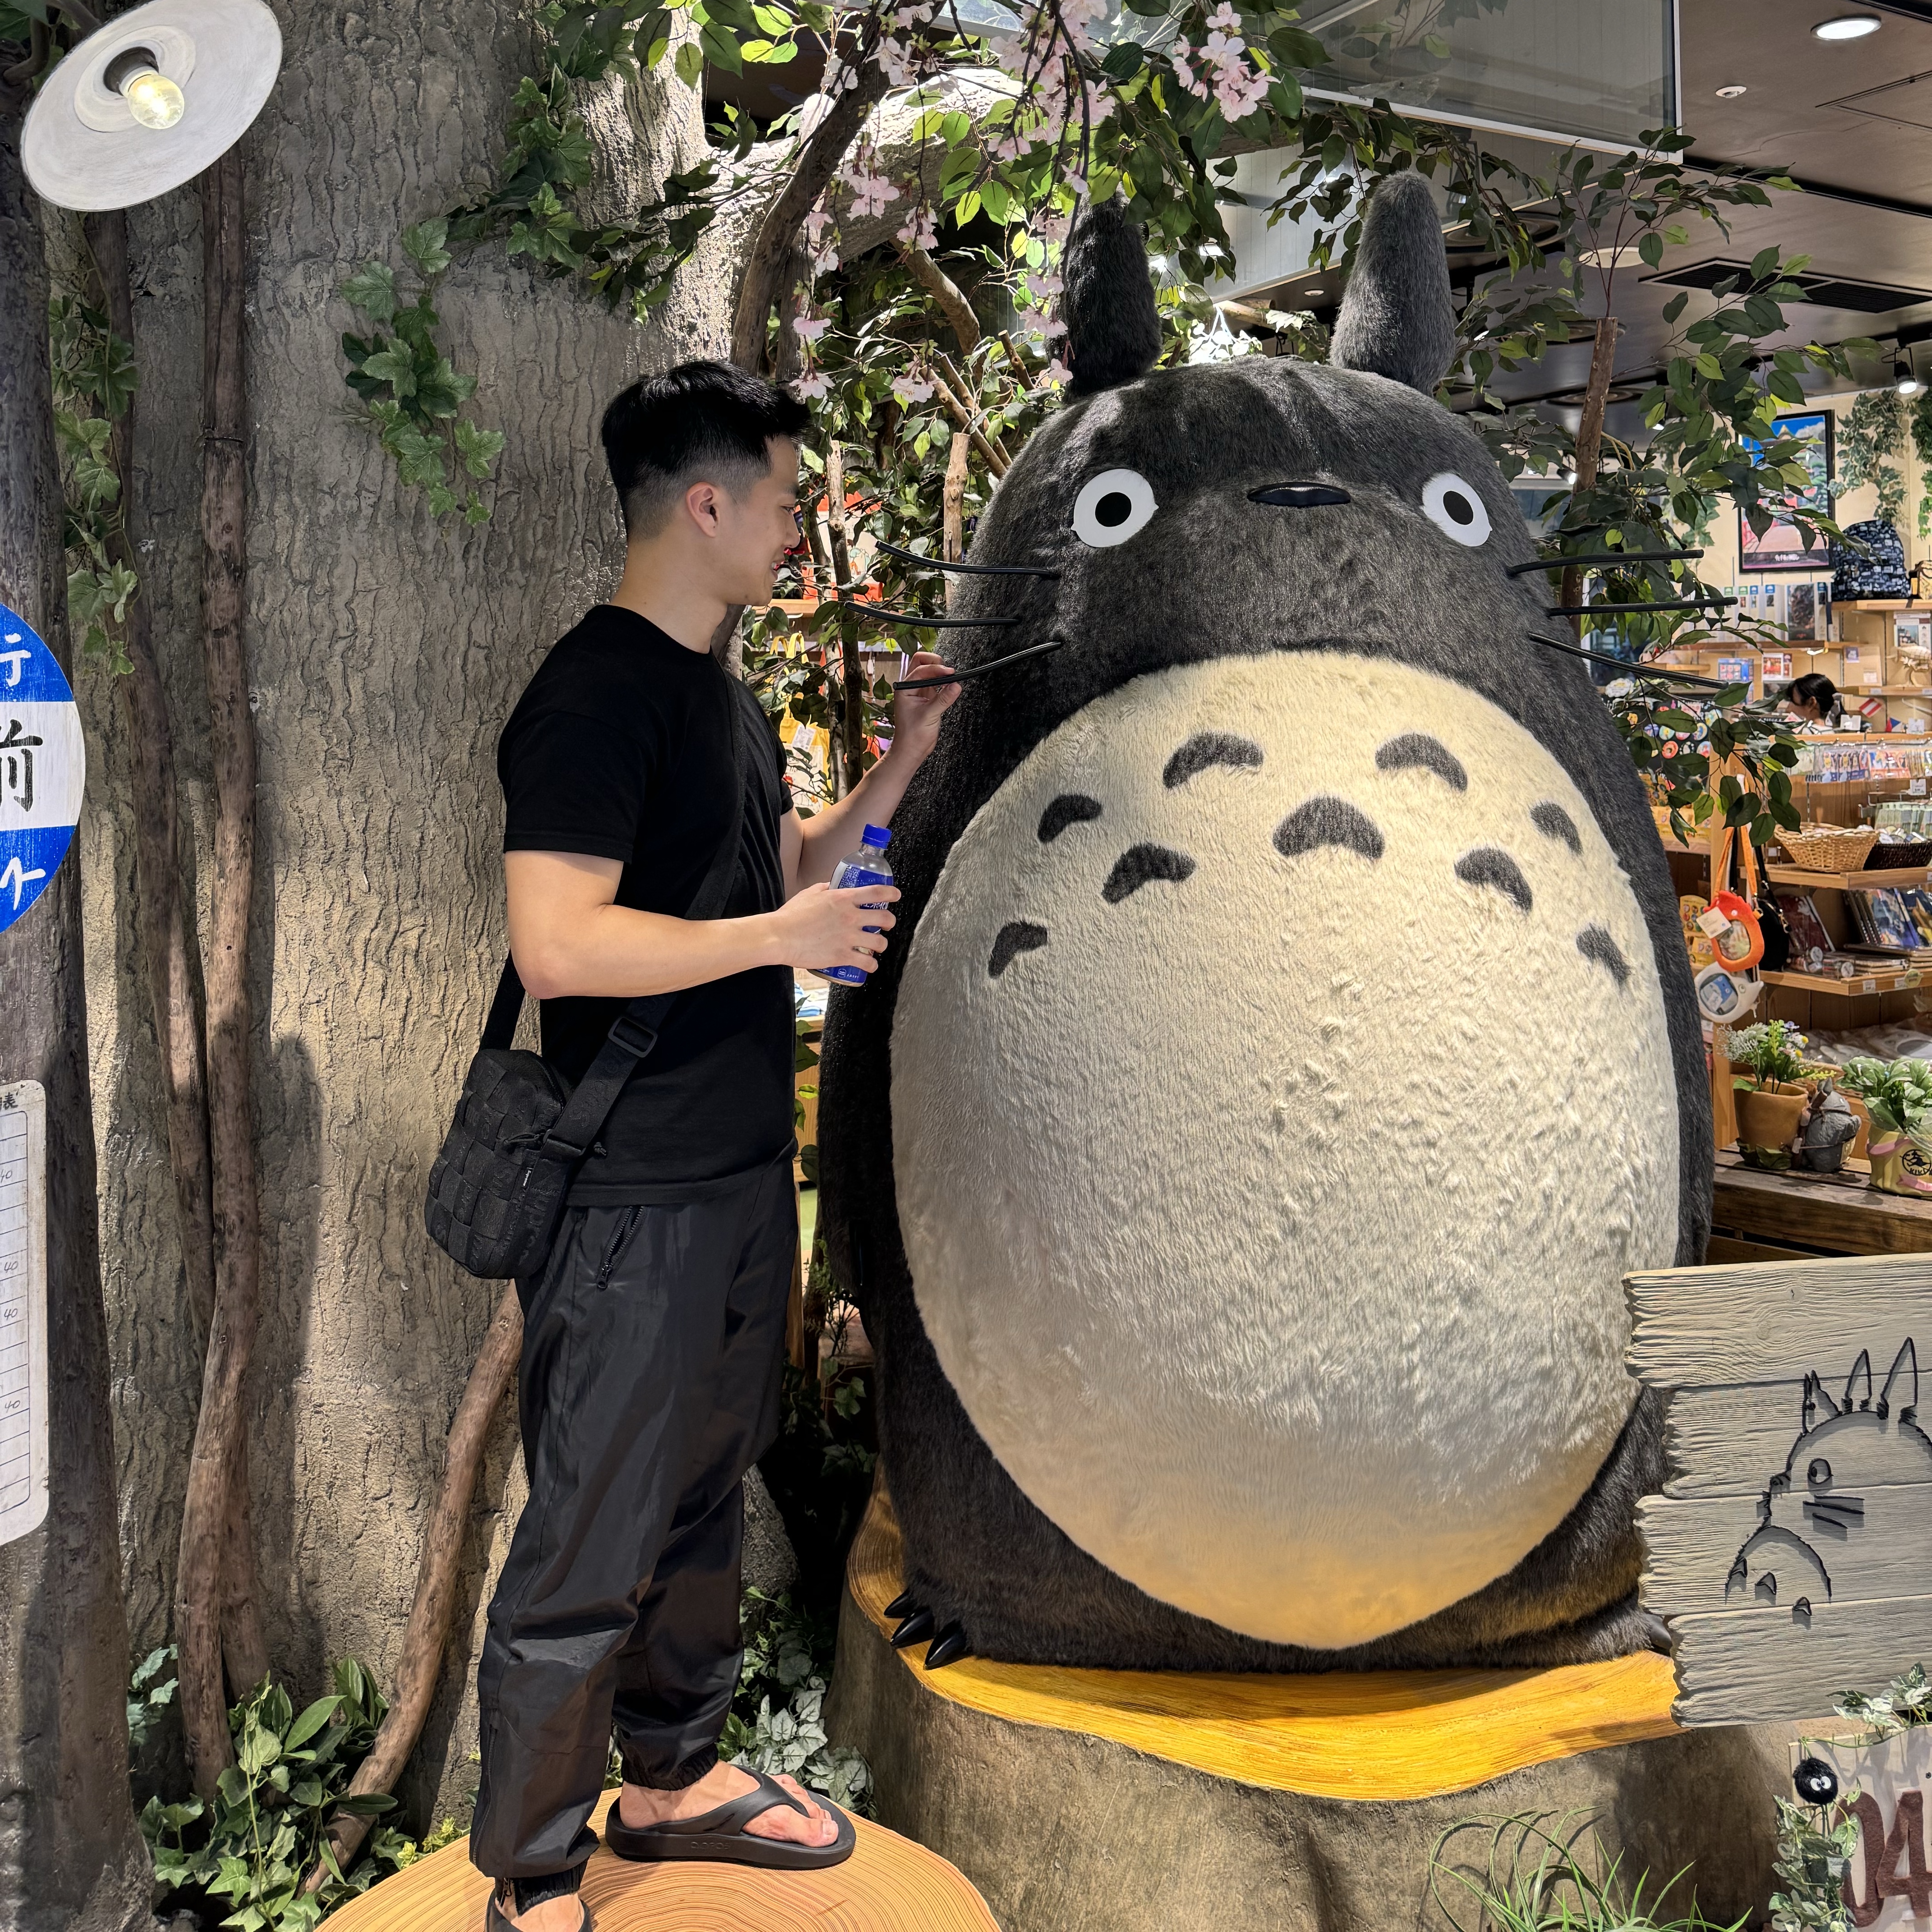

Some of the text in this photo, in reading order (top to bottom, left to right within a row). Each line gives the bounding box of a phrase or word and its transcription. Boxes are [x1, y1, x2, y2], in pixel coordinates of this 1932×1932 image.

[0, 1091, 18, 1111] 表
[4, 1261, 18, 1273] 40
[4, 1308, 18, 1320] 40
[5, 1400, 20, 1413] 40
